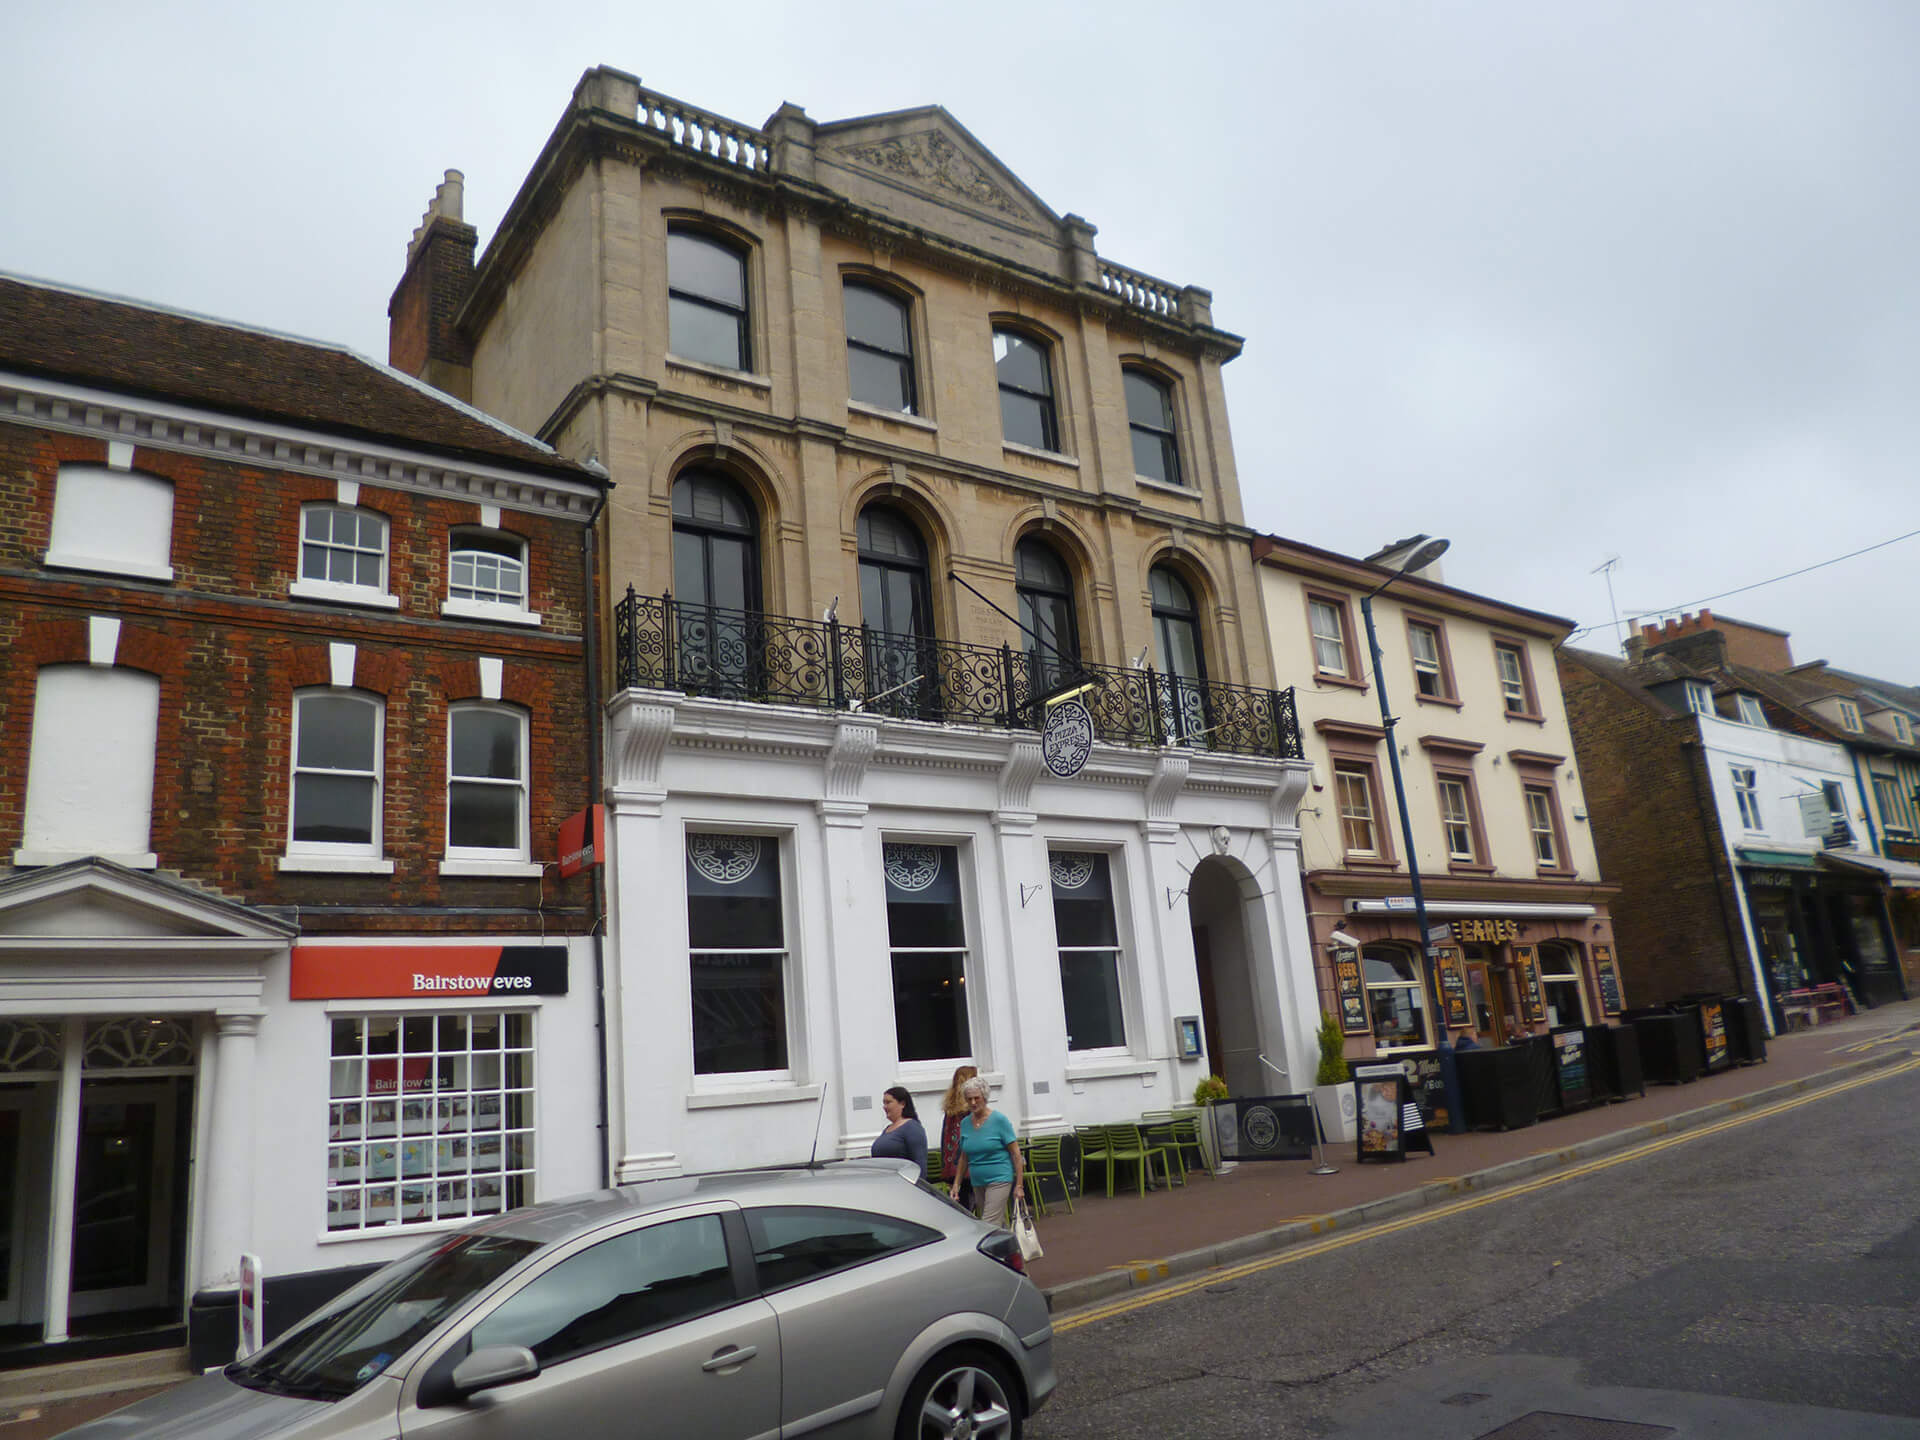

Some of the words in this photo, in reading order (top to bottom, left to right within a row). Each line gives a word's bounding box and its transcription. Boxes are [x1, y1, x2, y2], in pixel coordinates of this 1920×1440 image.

[1055, 726, 1077, 740] PIZZA
[1050, 734, 1085, 752] EXPRESS
[695, 839, 753, 851] EXPRESS
[412, 974, 492, 990] Bairstow
[493, 976, 532, 989] eves
[375, 1079, 422, 1089] Bairtow
